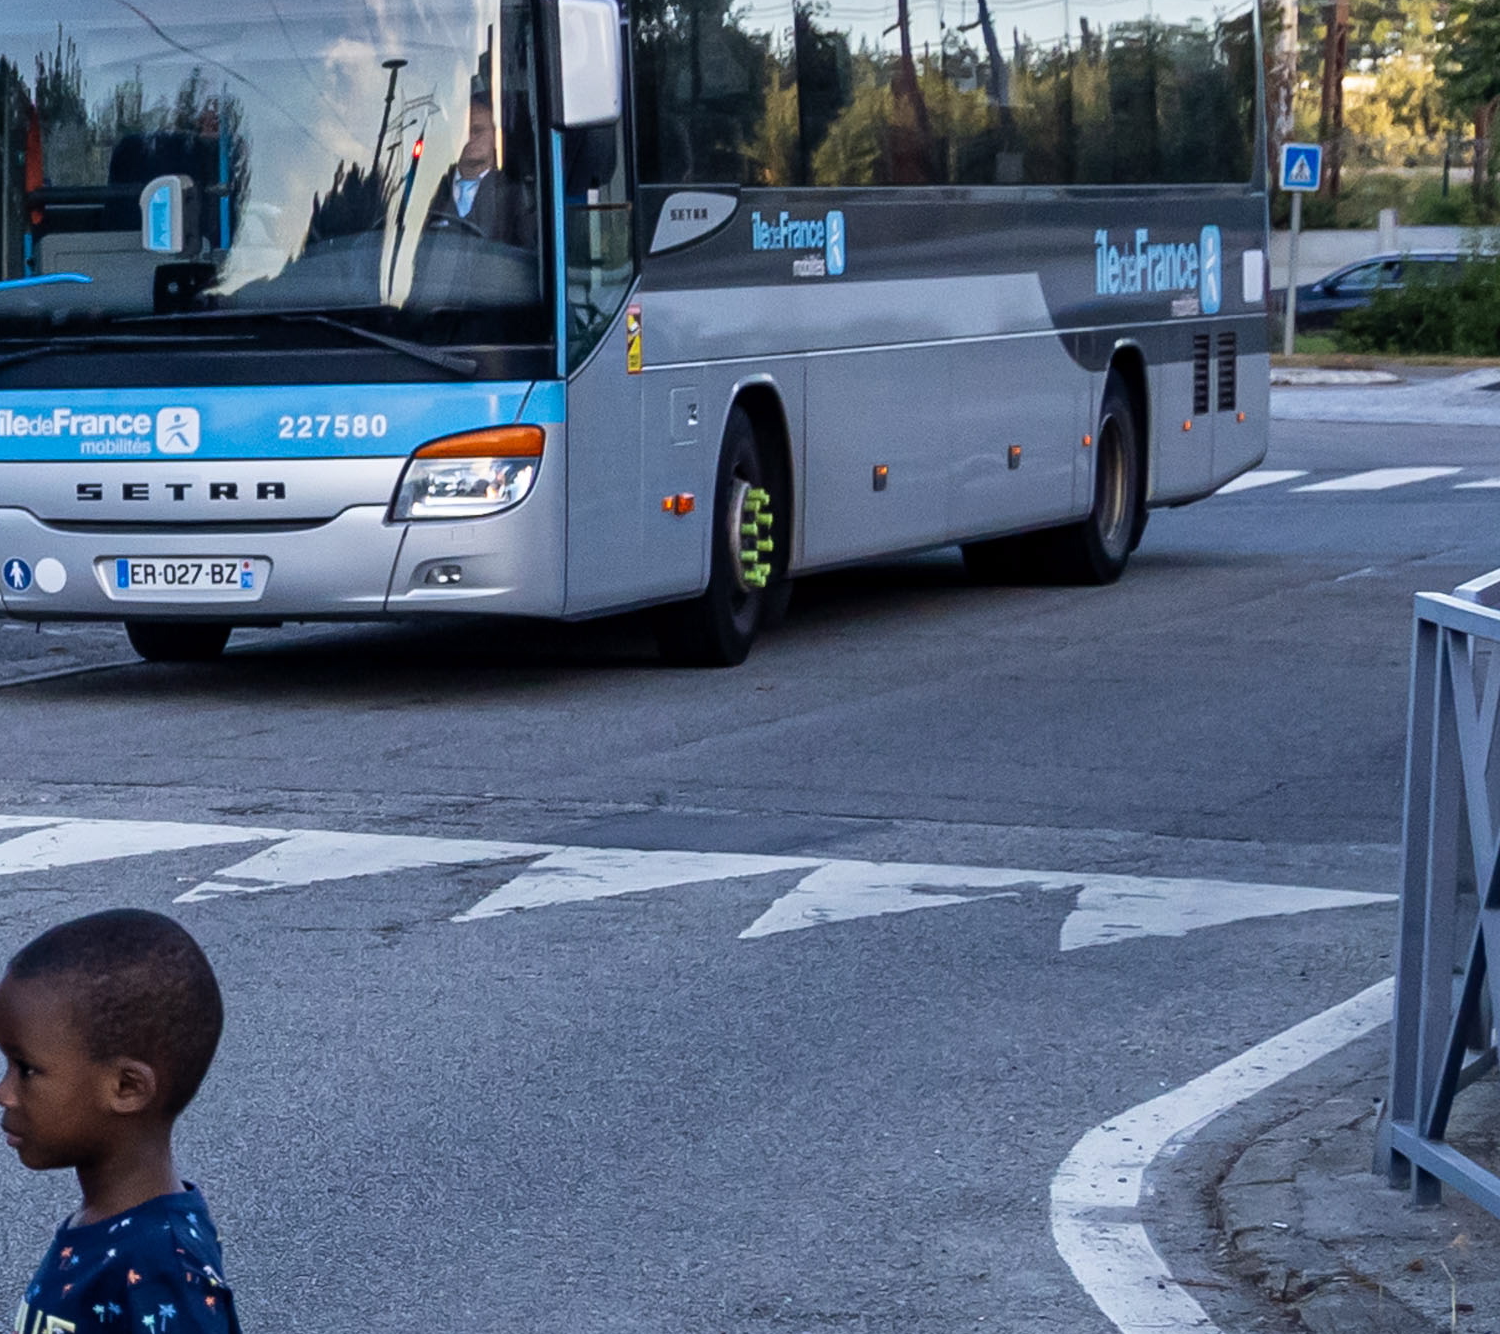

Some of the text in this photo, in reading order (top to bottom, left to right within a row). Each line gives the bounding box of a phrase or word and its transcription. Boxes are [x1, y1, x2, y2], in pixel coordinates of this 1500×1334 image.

[278, 414, 388, 439] 227580
[80, 435, 152, 455] mobilités
[76, 482, 287, 501] SETRA
[131, 563, 238, 585] ER-027-BZ
